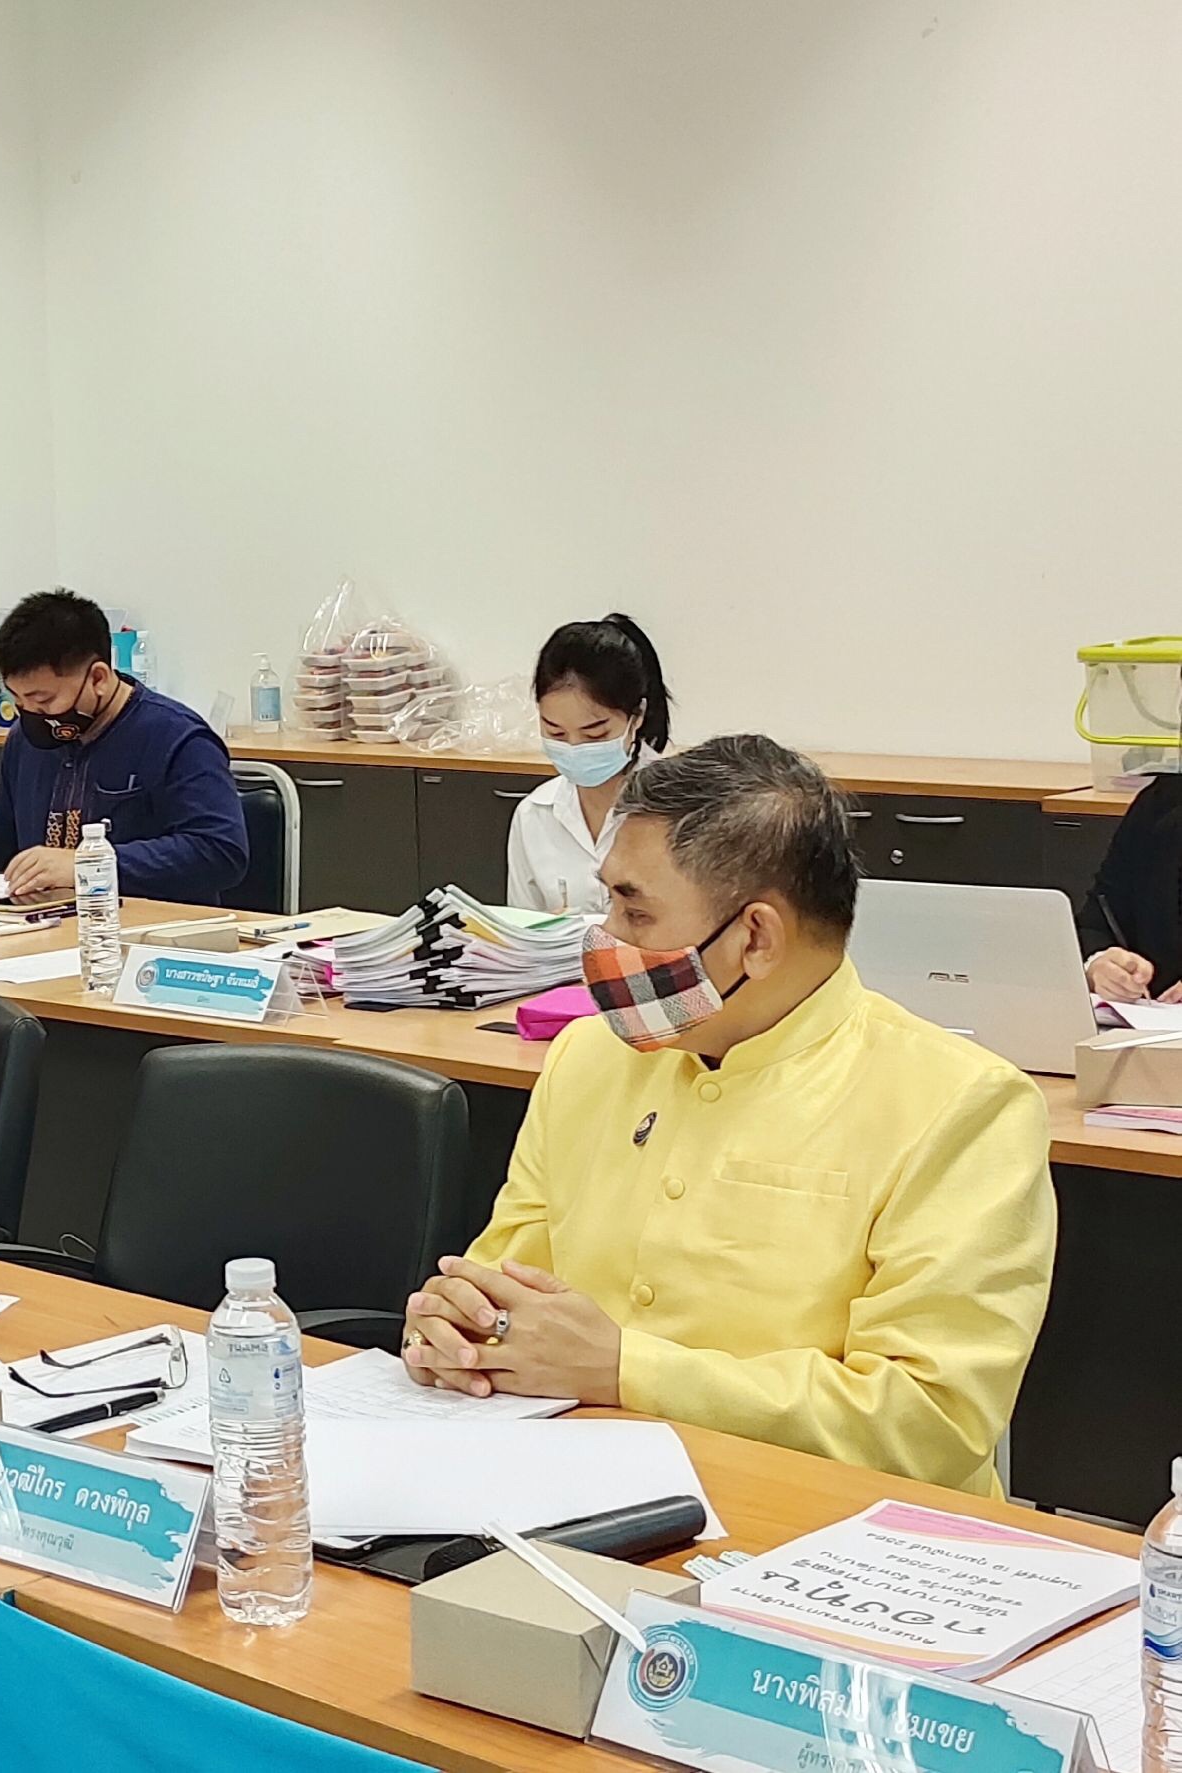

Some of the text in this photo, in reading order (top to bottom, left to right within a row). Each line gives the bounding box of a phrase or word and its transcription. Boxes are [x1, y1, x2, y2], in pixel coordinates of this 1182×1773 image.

[75, 1486, 151, 1530] ดวงพิกุล
[16, 1520, 75, 1552] ทรงคุณวุฒิ
[907, 1542, 988, 1567] กุมภาพันธ์
[791, 1558, 1008, 1617] พัฒนาบทบาทสตรี
[820, 1550, 911, 1581] จังหวัดน่าน
[730, 1586, 937, 1645] คณะอนุกรรมการบริหาร
[761, 1570, 986, 1635] กองทุน
[752, 1666, 868, 1722] นางพิสม
